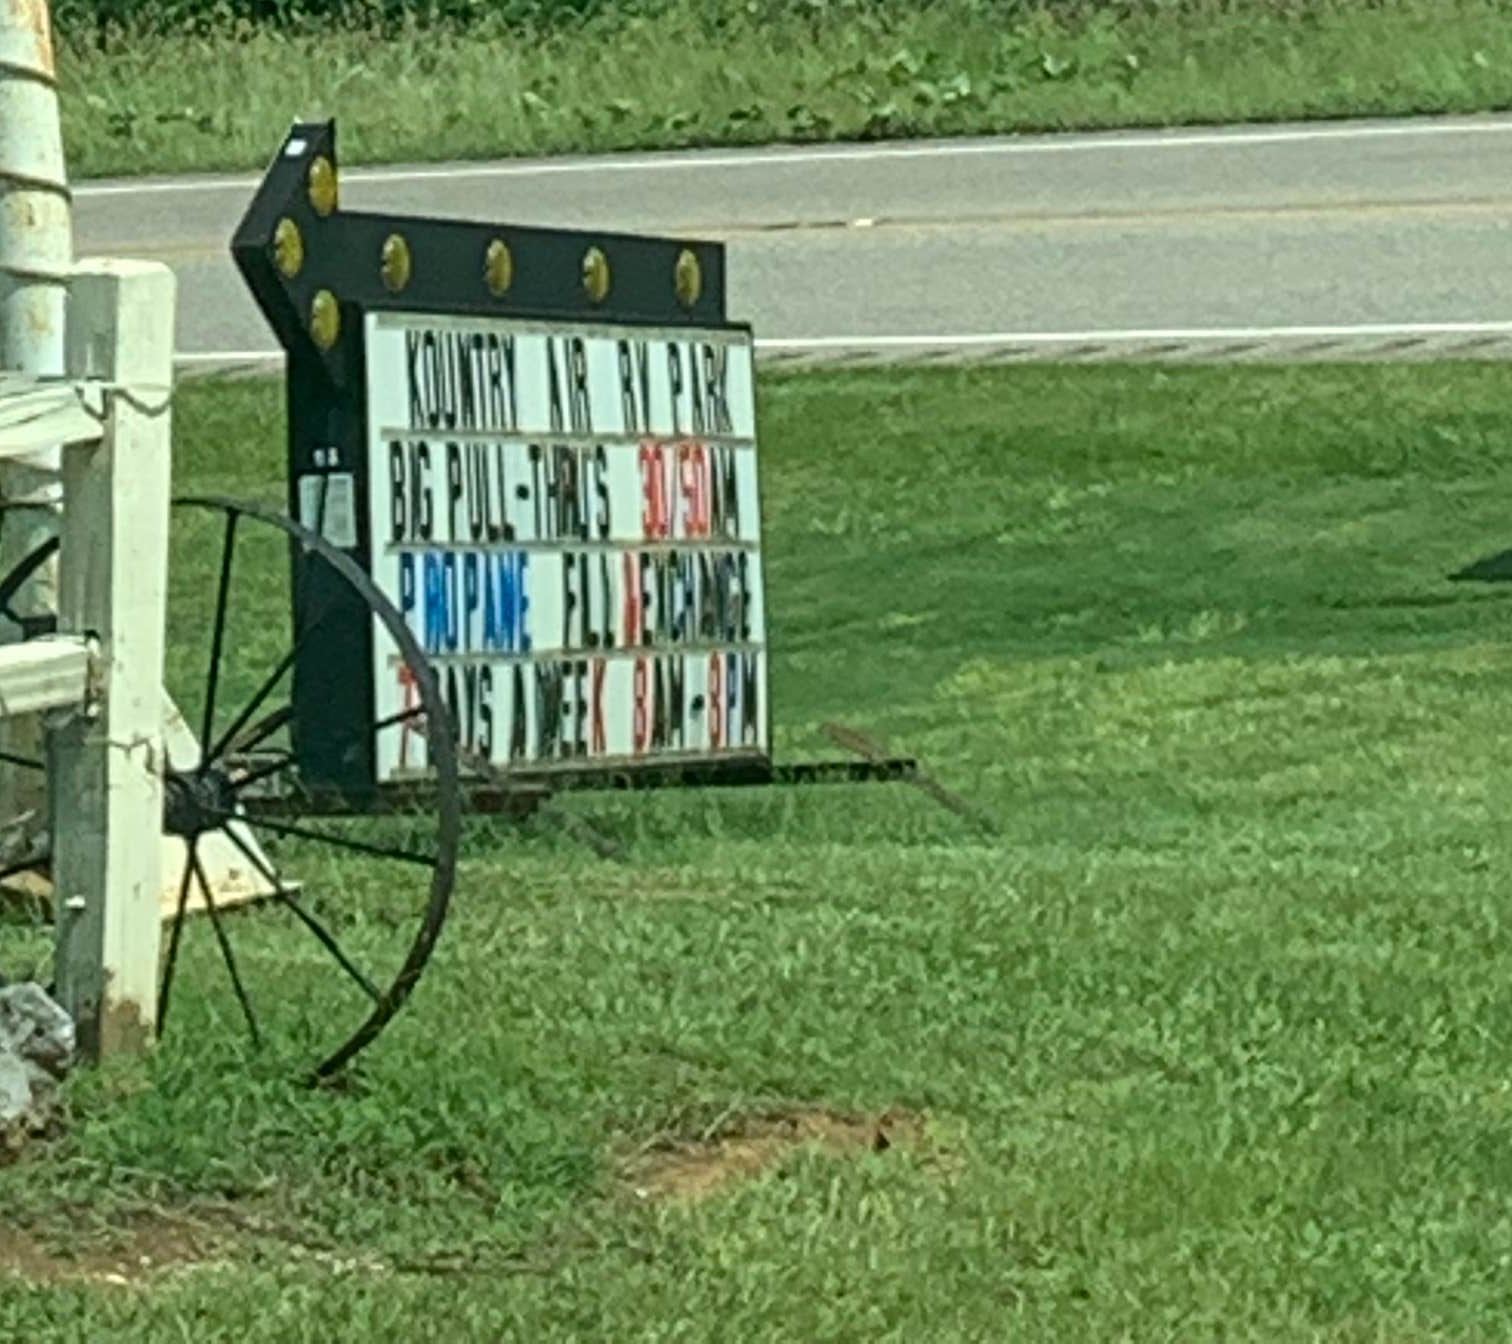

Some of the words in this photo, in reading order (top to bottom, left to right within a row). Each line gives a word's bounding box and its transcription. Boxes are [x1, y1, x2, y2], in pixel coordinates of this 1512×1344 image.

[406, 329, 519, 433] KOUNTRY
[547, 335, 593, 434] AIR
[618, 339, 650, 434] RV
[666, 341, 733, 435] PARK
[390, 440, 434, 542] BIG
[399, 550, 532, 655] PROPANE
